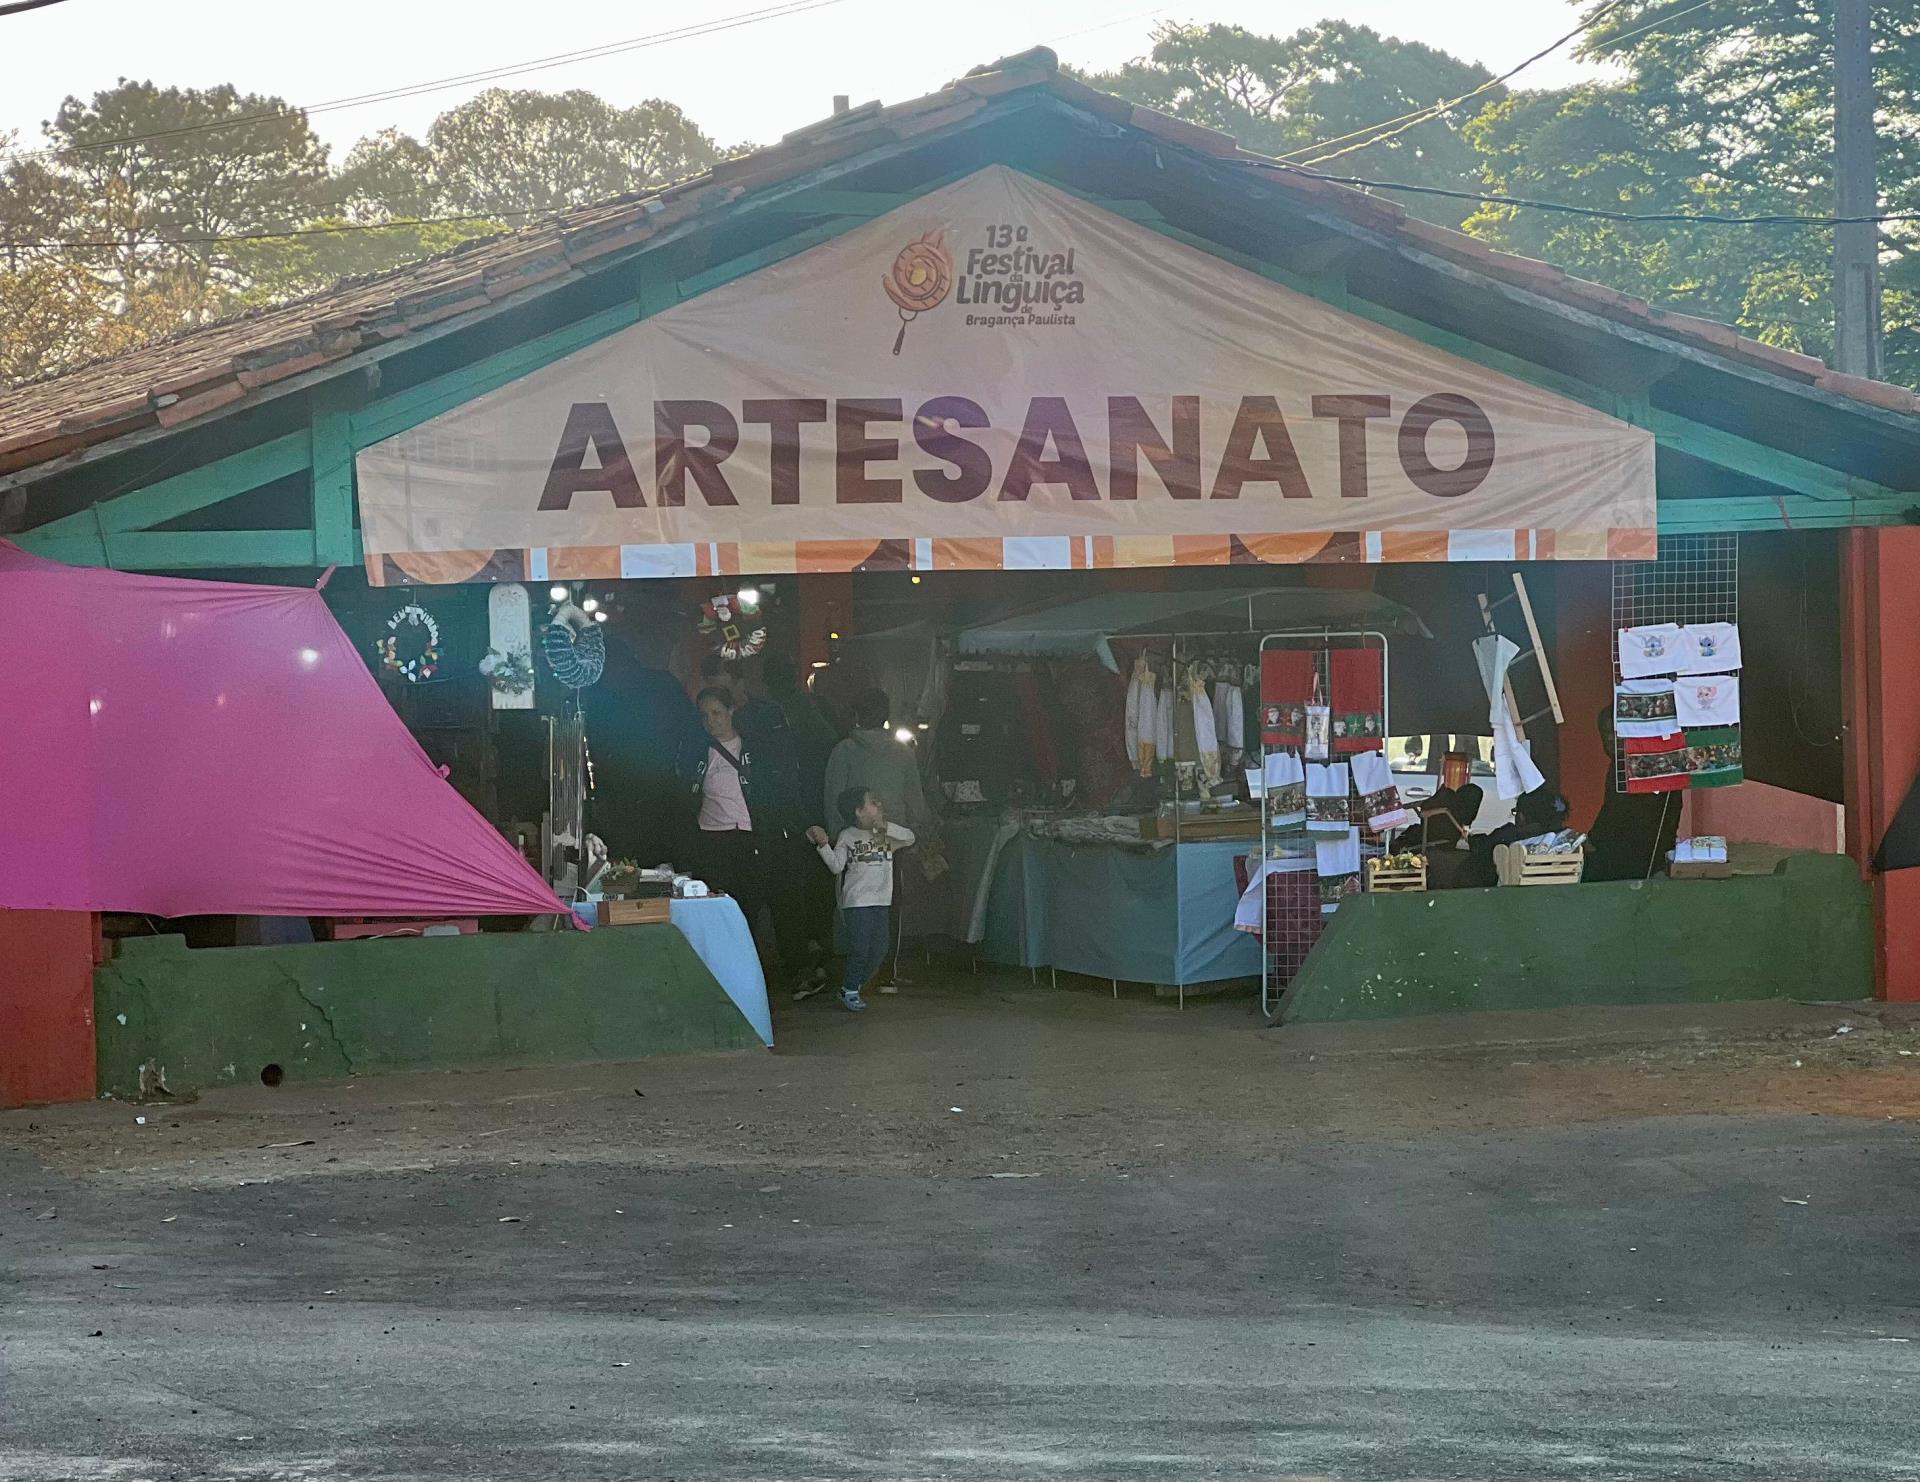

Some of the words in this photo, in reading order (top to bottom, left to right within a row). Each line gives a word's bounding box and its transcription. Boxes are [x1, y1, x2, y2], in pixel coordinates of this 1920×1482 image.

[986, 224, 1028, 248] 13º
[967, 246, 1075, 275] Festival
[1009, 271, 1023, 282] da
[956, 273, 1085, 313] Linguiça
[1020, 303, 1033, 314] de
[966, 314, 1024, 328] Bragança
[1027, 314, 1076, 326] Paulista
[537, 393, 1496, 511] ARTESANATO
